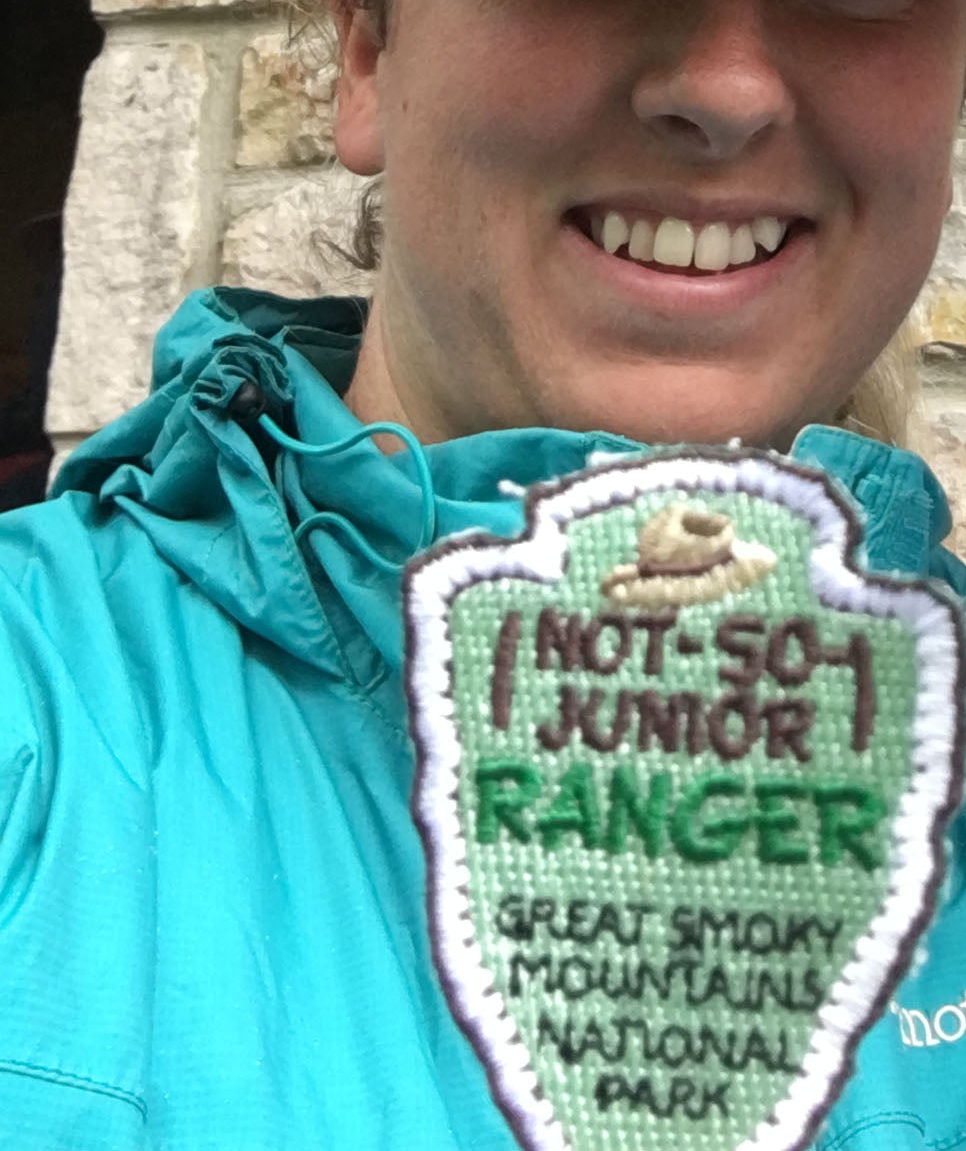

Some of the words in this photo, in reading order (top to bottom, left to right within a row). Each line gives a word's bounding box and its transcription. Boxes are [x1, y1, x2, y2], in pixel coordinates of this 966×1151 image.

[536, 685, 816, 762] JUNIOR
[475, 757, 887, 871] RANGER
[496, 895, 657, 946] GREAT
[671, 905, 844, 955] SMOKY
[509, 953, 828, 1011] MOUNTAINS
[537, 1012, 803, 1073] NATIONAL
[596, 1074, 731, 1119] PARK
